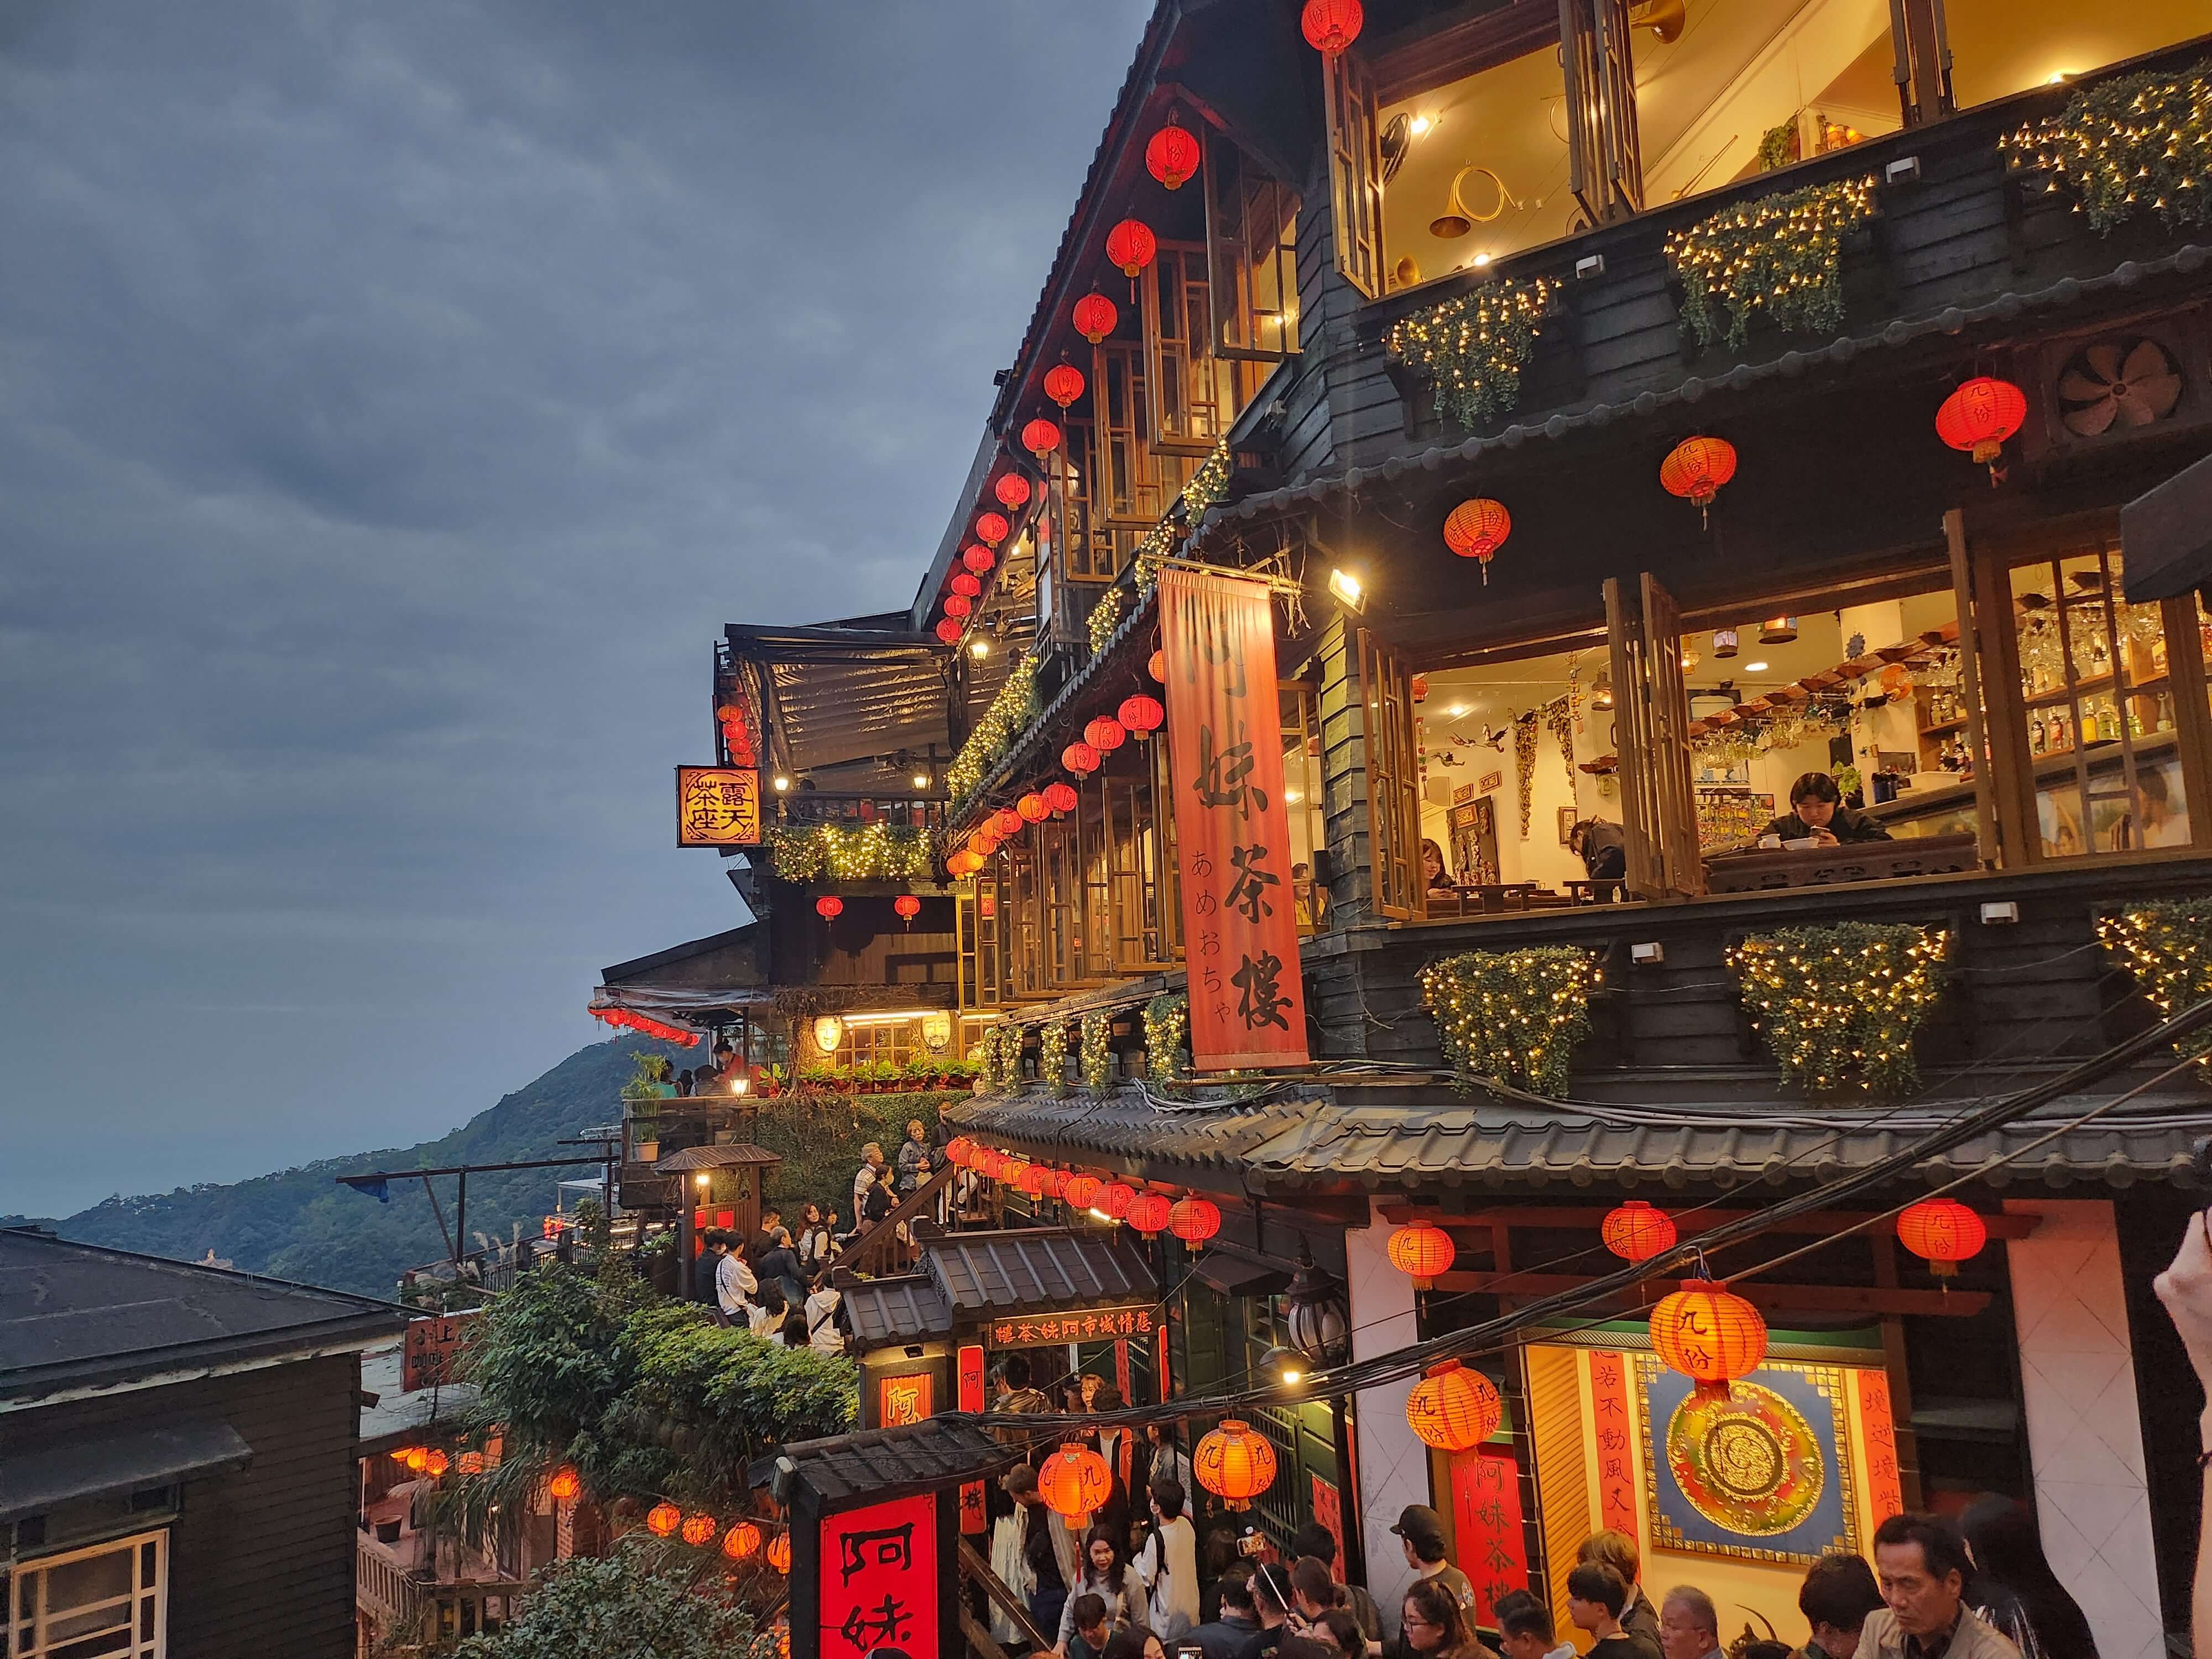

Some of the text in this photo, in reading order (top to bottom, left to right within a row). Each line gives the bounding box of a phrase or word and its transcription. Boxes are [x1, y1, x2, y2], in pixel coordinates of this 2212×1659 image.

[1970, 385, 1994, 424] 九份
[1683, 445, 1704, 474] 九份
[1127, 700, 1138, 723] 九份
[686, 780, 720, 830] 茶座
[718, 782, 754, 830] 露天
[1178, 594, 1293, 1031] 阿妹茶樓
[1191, 850, 1231, 1024] あめおちゃ
[1113, 1190, 1124, 1214] 九份
[1149, 1203, 1160, 1229] 九份
[1193, 1208, 1204, 1237] 九份
[1611, 1217, 1629, 1255] 九份
[1932, 1214, 1952, 1254] 九份
[1401, 1237, 1416, 1271] 九份
[1677, 1310, 1714, 1370] 九份
[1416, 1395, 1445, 1443] 九份
[839, 1521, 915, 1652] 阿妹
